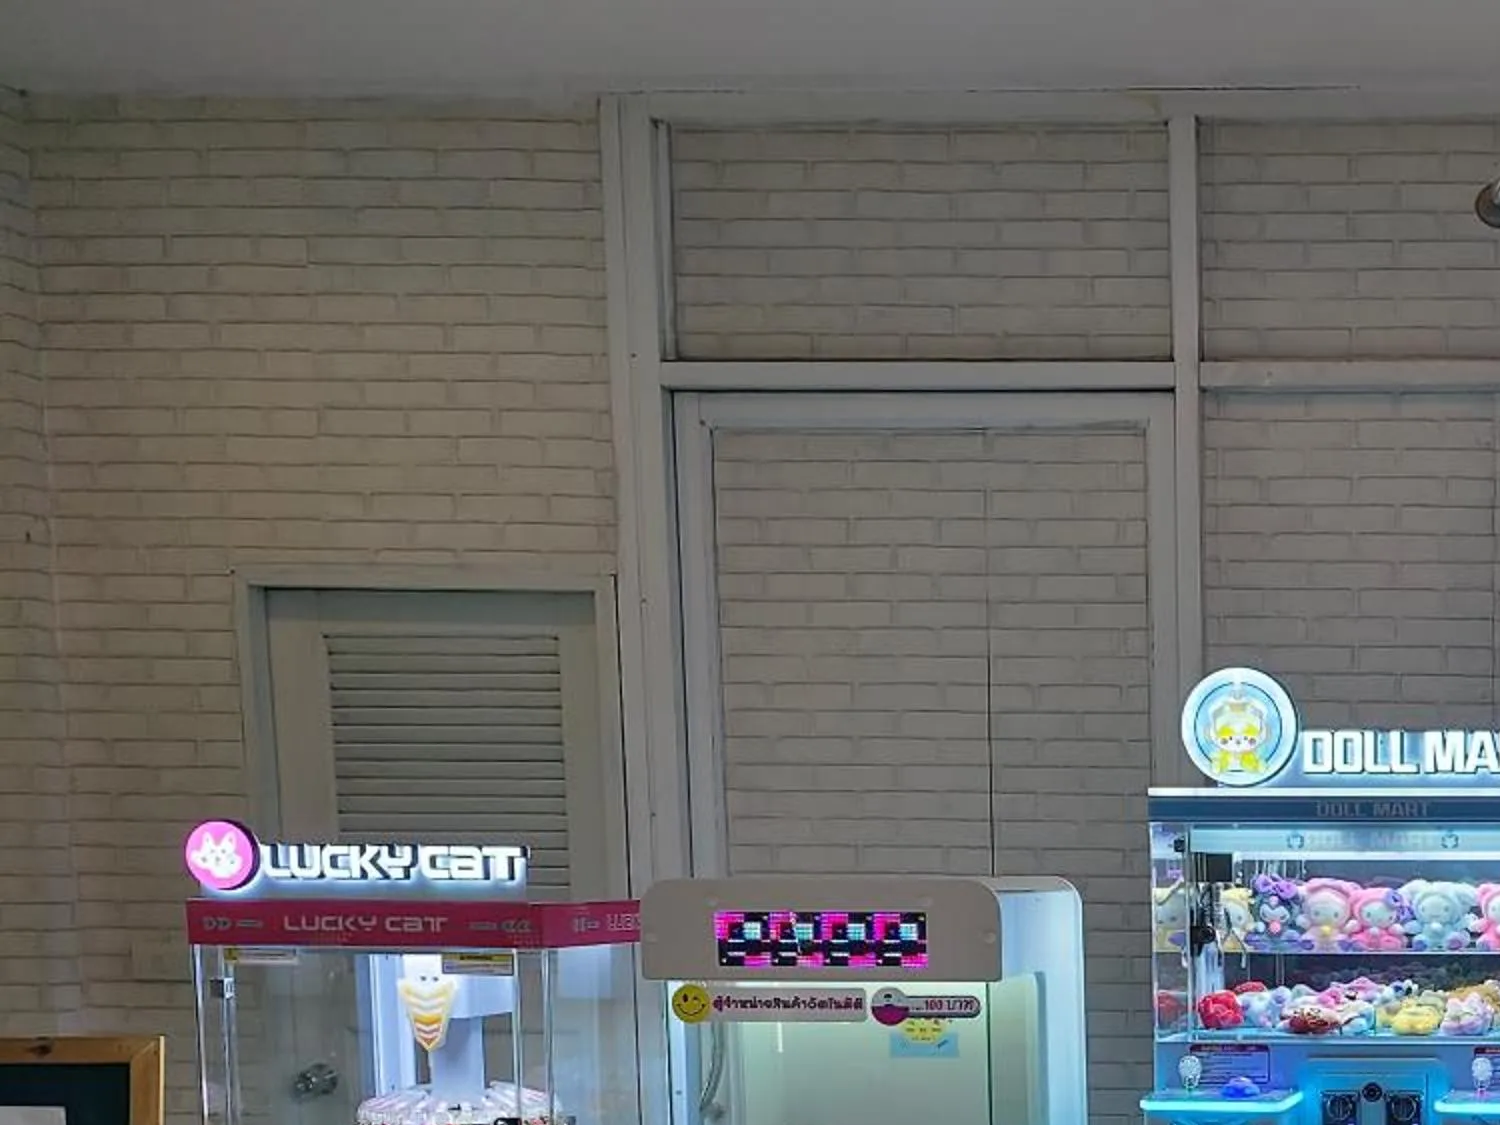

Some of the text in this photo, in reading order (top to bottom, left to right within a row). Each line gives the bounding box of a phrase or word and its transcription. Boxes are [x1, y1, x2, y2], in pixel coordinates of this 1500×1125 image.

[1302, 729, 1421, 775] DOLL
[1373, 800, 1430, 817] MART
[262, 843, 414, 880] LUCKY
[283, 915, 378, 932] LUCKY
